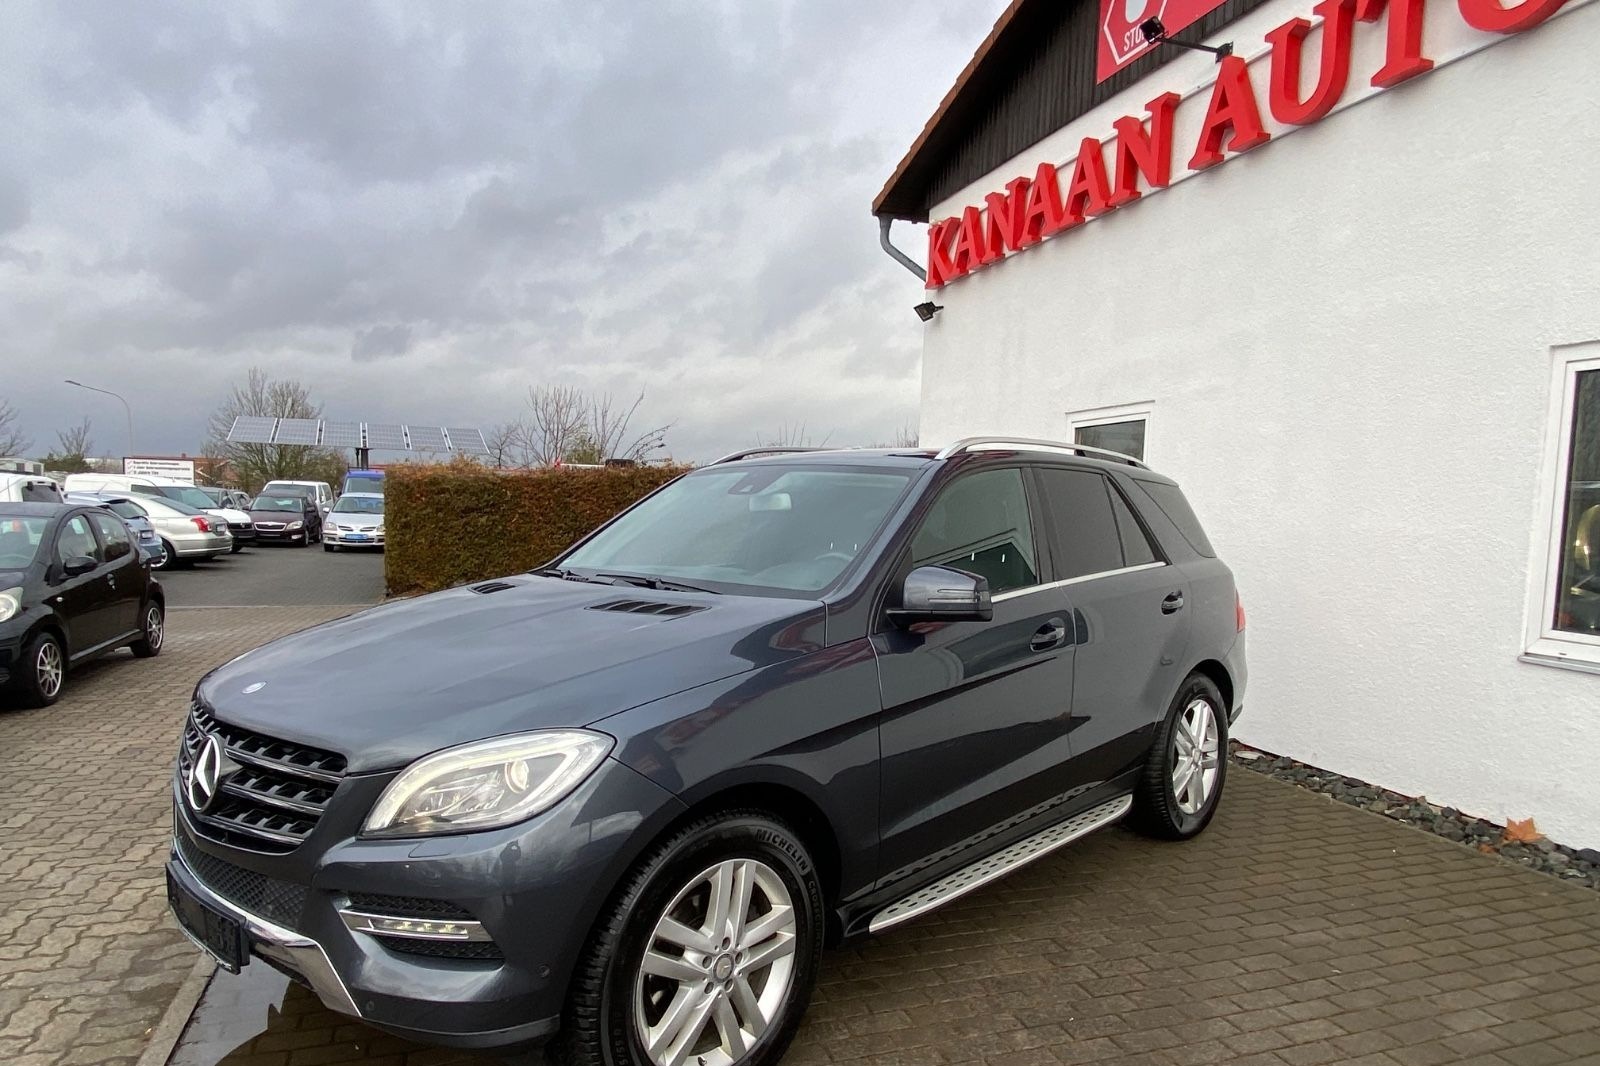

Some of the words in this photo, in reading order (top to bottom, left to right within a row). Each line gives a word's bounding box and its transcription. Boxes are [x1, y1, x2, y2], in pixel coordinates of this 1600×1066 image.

[1124, 24, 1144, 51] STO
[925, 92, 1182, 288] KANAAN
[1188, 0, 1571, 170] AUT
[755, 829, 808, 871] MICHELIN
